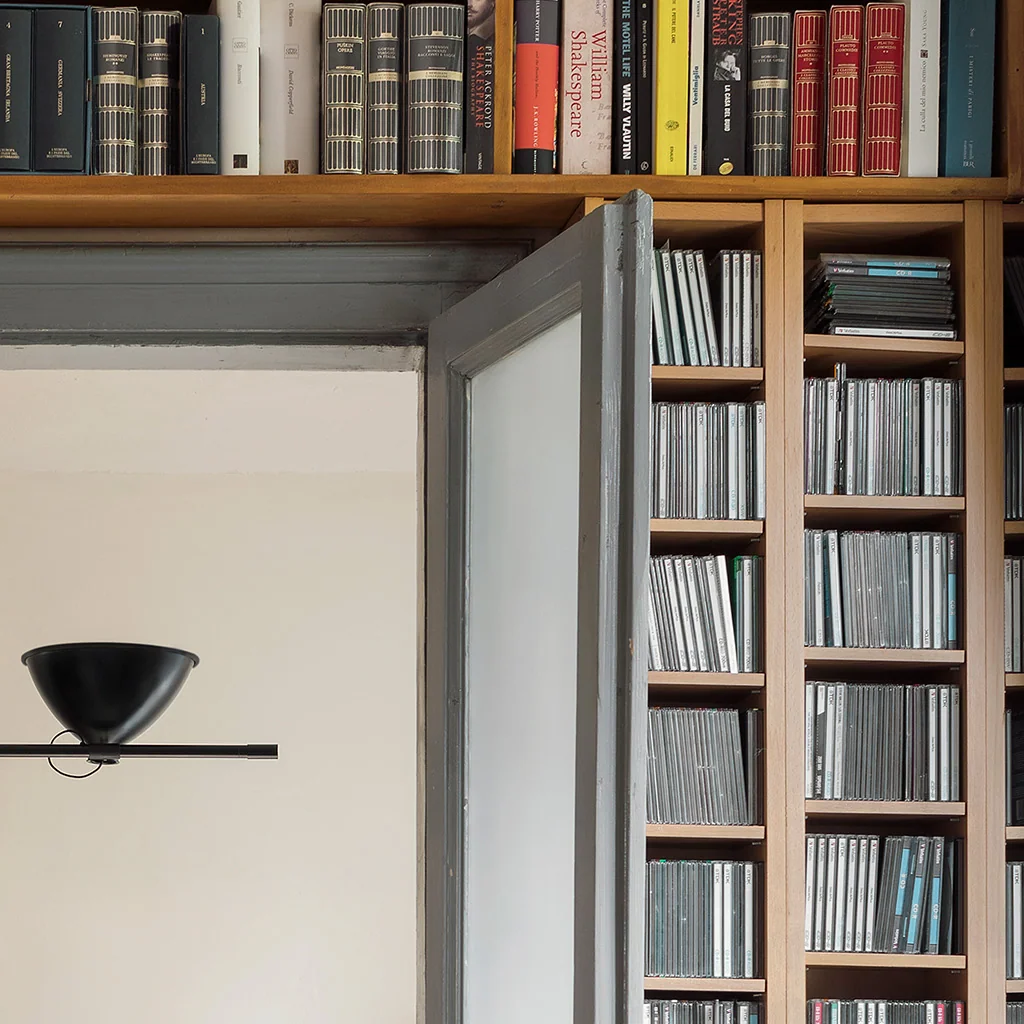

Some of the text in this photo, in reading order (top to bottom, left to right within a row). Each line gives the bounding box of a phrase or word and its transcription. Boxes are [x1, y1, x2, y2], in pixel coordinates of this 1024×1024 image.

[5, 21, 11, 29] 4
[57, 20, 63, 29] 7
[712, 0, 721, 46] STRAUB
[727, 0, 736, 45] KING
[735, 0, 743, 45] STEPHEN
[475, 45, 485, 128] SHAKESPEARE
[484, 45, 492, 129] PETER ACKROYD
[565, 30, 587, 138] Shakespeare
[590, 29, 608, 101] William
[622, 0, 631, 160] THE MOTEL LIFE WILLY VLAUTIN
[724, 84, 730, 92] LA
[968, 88, 974, 96] di
[919, 124, 926, 132] La
